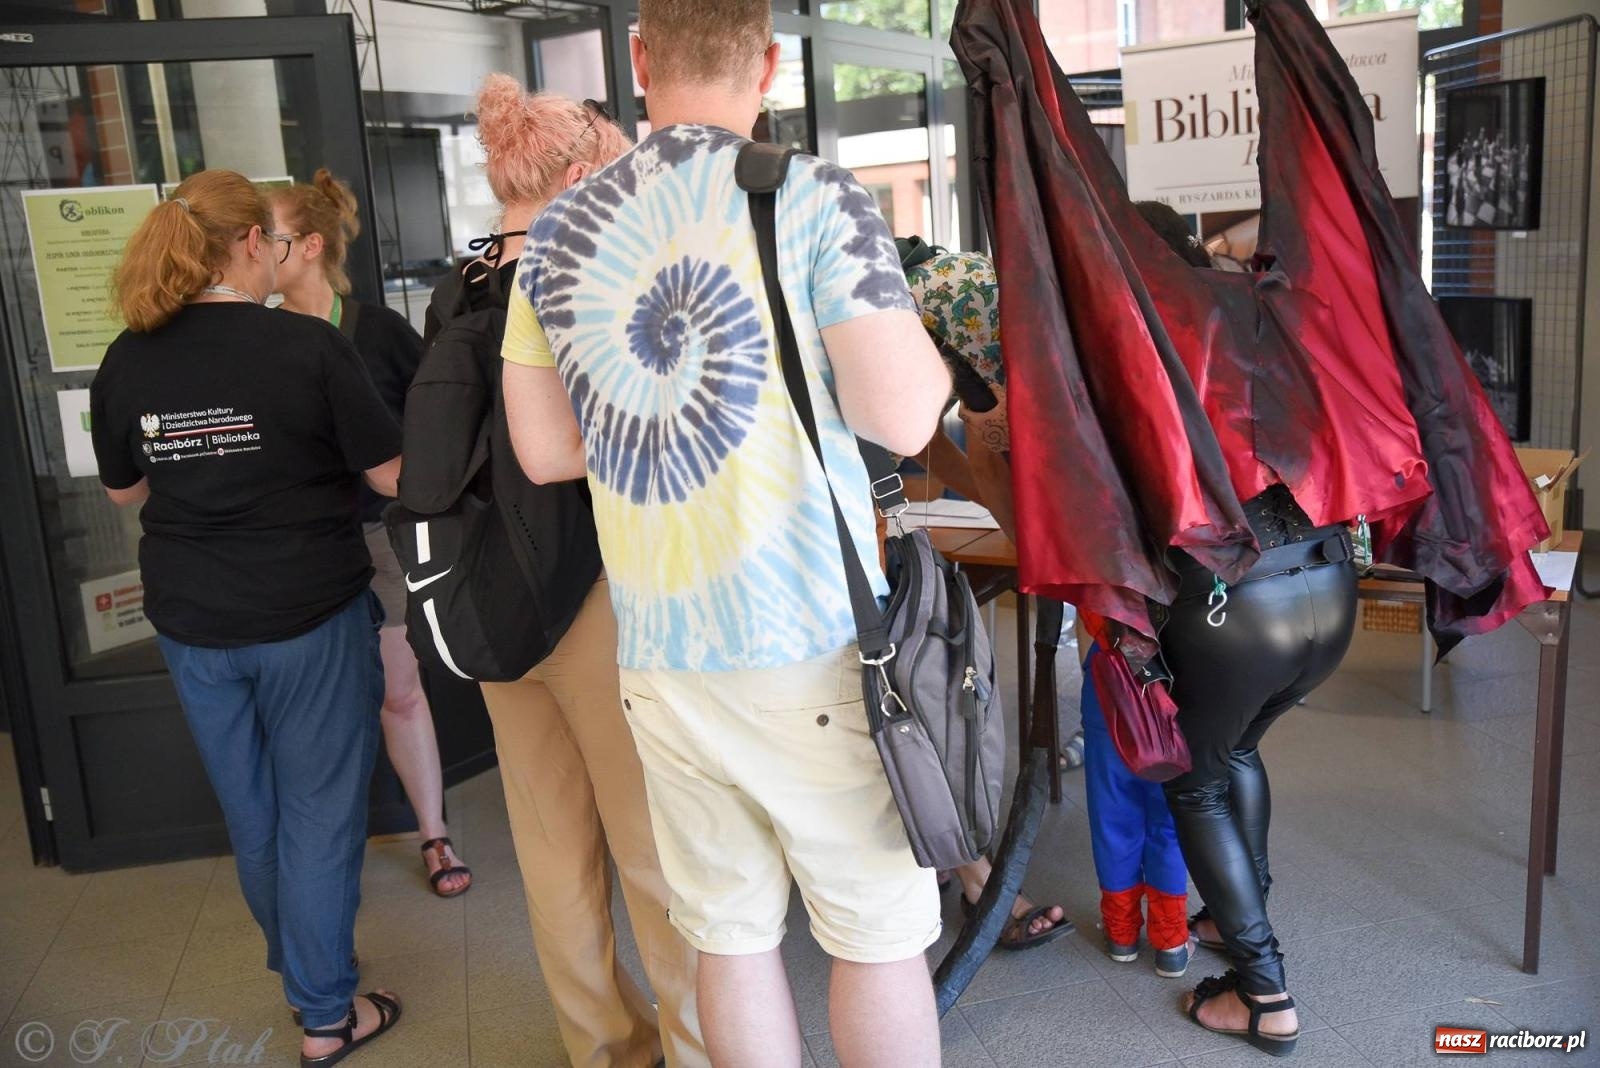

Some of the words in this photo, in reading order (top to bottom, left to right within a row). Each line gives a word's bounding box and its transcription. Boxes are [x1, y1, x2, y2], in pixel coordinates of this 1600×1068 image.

[1179, 190, 1241, 204] RYSZARDA
[160, 410, 207, 421] Ministerstwo
[207, 406, 234, 416] Kultury
[166, 418, 208, 430] Dziedzictwa
[208, 414, 253, 425] Narodowego
[153, 438, 203, 451] Racibórz
[212, 432, 260, 445] Biblioteka
